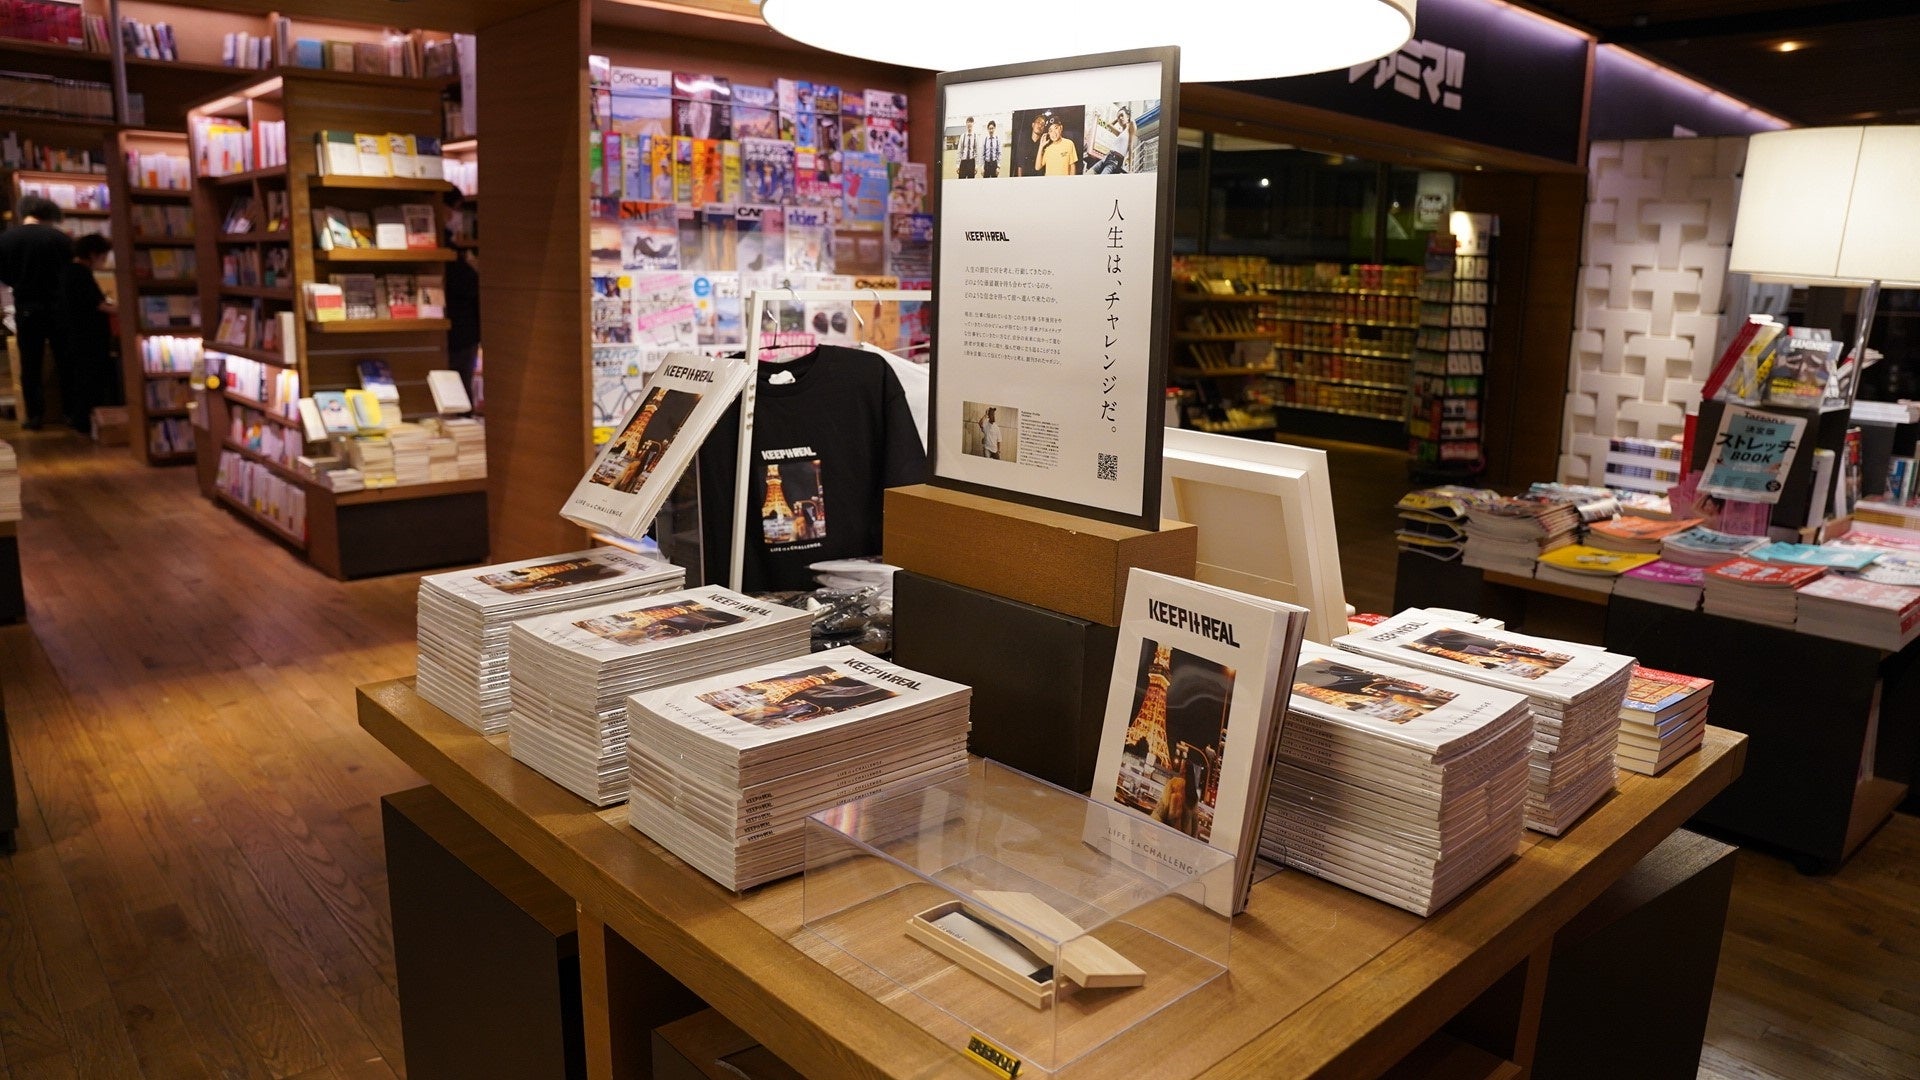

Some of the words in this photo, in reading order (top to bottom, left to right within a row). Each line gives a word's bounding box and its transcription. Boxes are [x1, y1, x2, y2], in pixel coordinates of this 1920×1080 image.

[1100, 199, 1125, 434] 人生は、チャレンジだ。
[1716, 432, 1797, 454] ストレッチ
[1730, 451, 1774, 463] BOOK
[1108, 827, 1126, 841] LIFE
